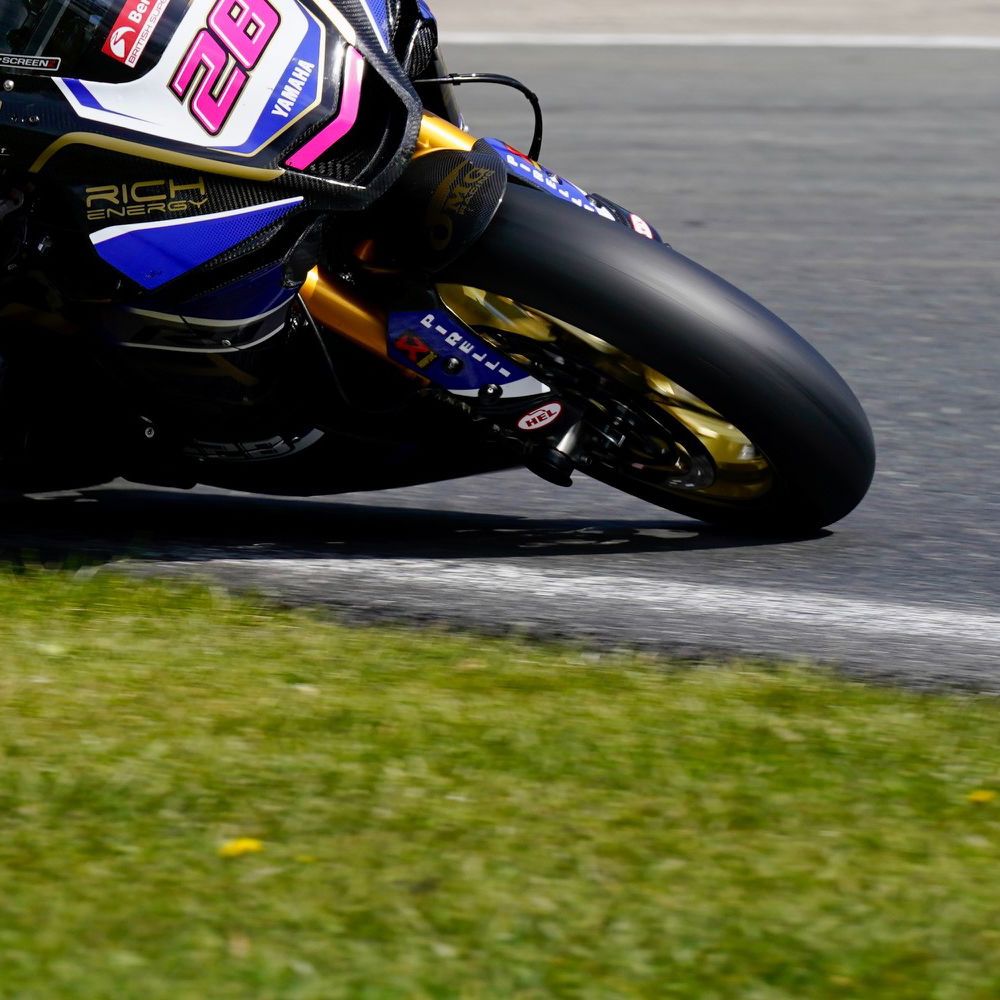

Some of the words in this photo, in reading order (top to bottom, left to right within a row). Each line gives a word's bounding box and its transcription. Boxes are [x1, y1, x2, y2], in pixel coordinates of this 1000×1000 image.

[127, 23, 155, 66] BRITISH
[271, 59, 315, 118] YAMAHA
[86, 178, 206, 209] RICH
[506, 154, 595, 212] PIRELLI
[87, 197, 207, 221] ENERGY
[420, 313, 511, 377] PIRELLI
[525, 410, 557, 427] HEL
